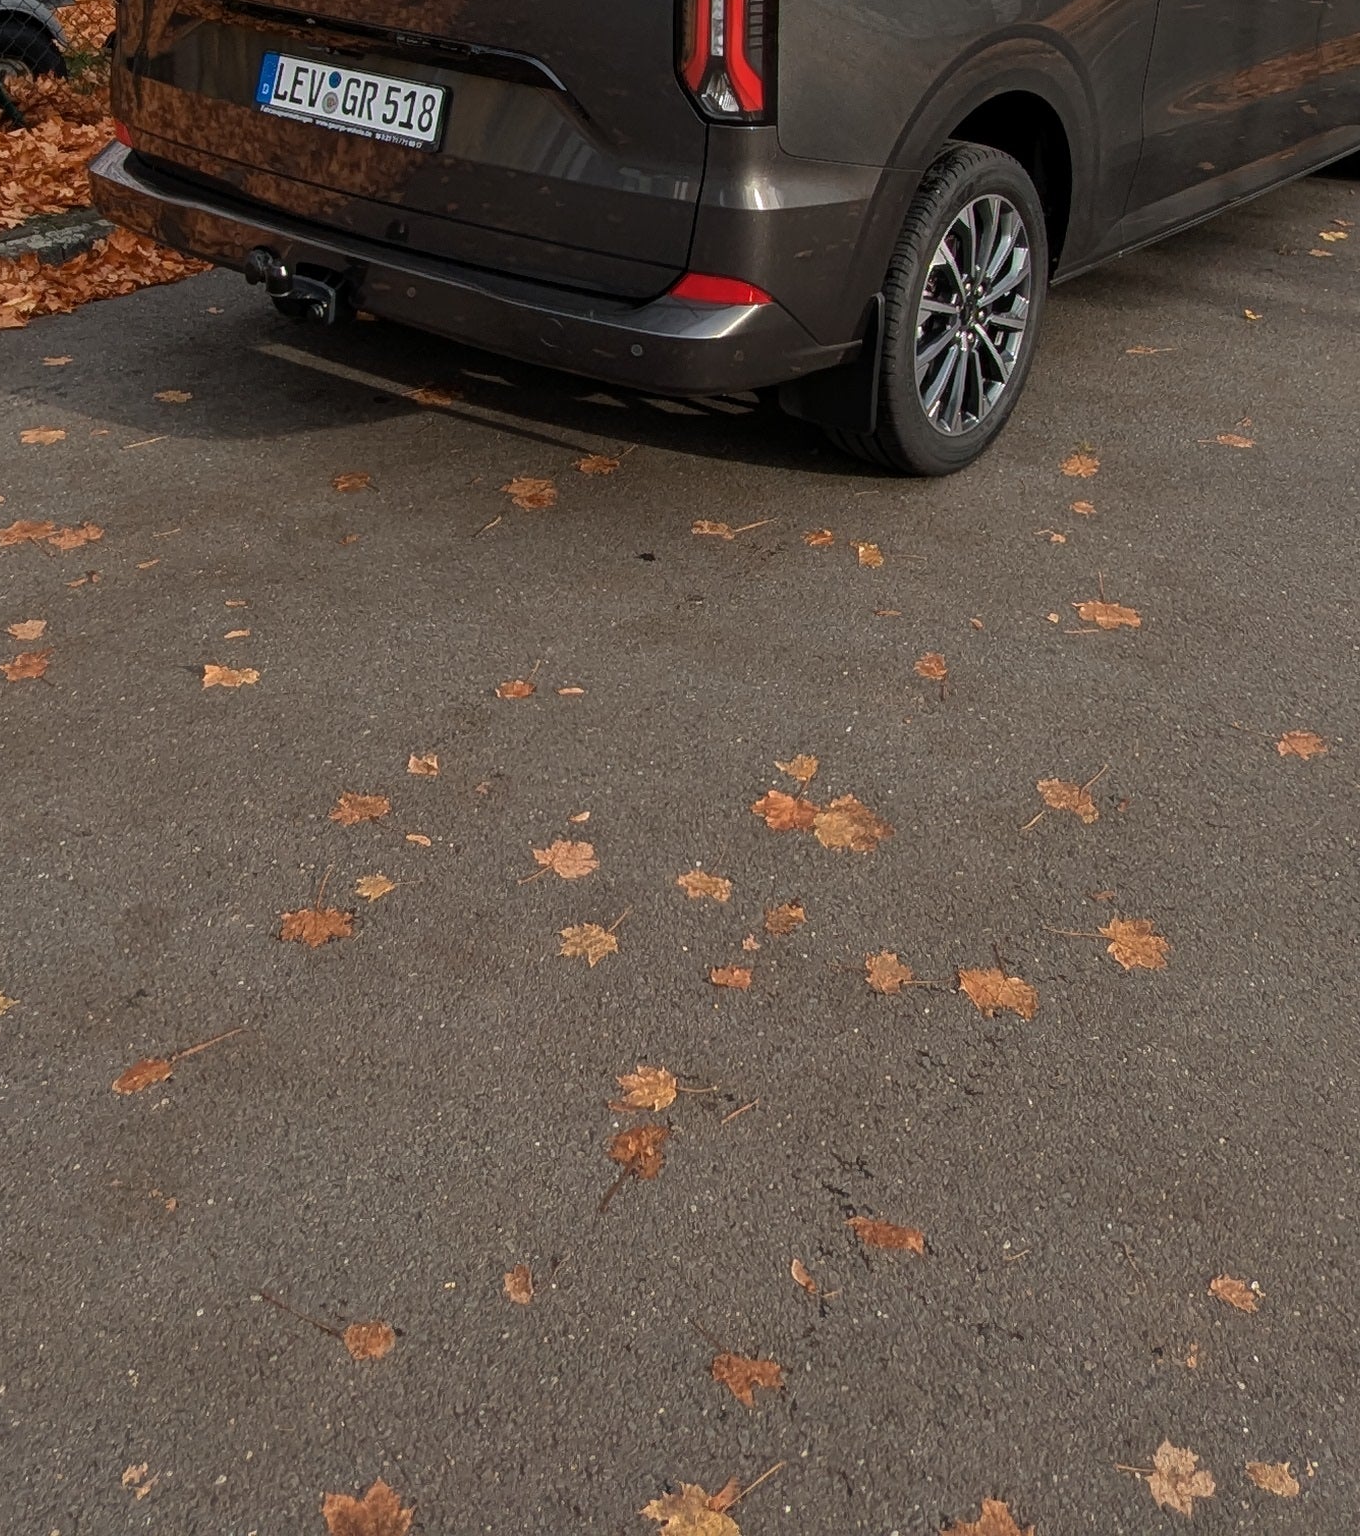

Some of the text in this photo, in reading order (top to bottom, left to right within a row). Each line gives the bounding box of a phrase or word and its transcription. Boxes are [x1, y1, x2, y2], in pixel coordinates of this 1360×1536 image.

[273, 63, 326, 107] LEV
[342, 77, 378, 121] GR
[382, 86, 436, 133] 518
